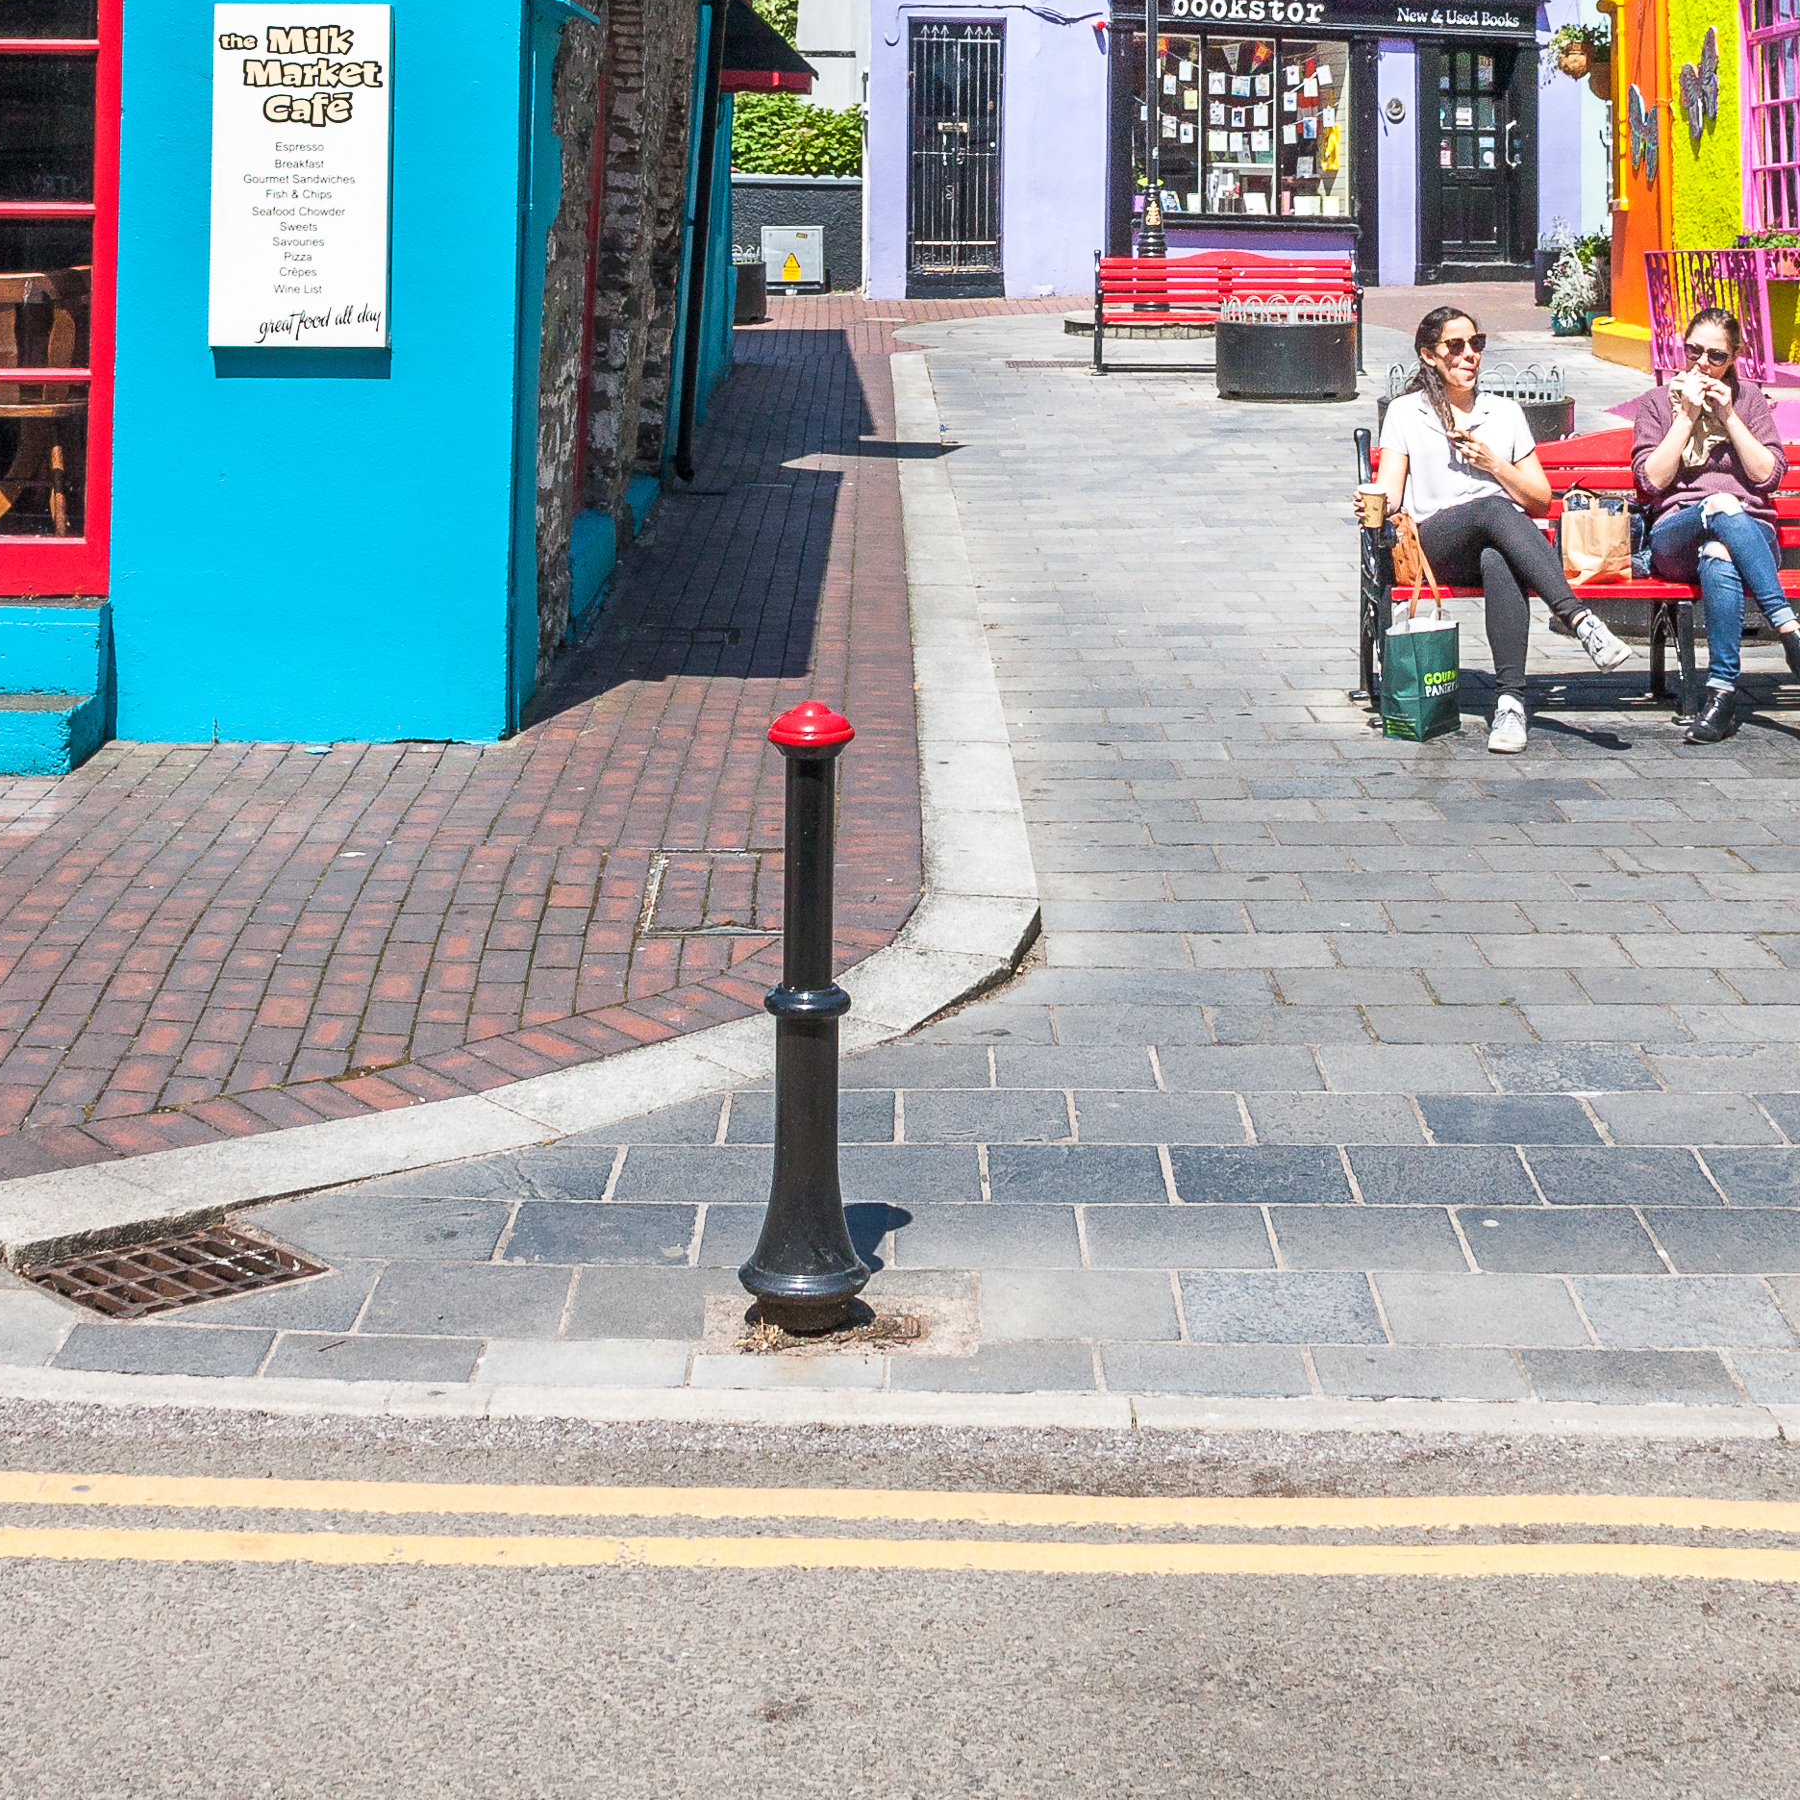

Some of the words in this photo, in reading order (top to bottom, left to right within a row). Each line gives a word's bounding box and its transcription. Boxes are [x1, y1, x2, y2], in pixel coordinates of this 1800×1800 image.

[1397, 7, 1428, 23] New
[1431, 9, 1443, 23] &
[1446, 9, 1479, 26] Used
[1482, 11, 1520, 28] Books
[220, 33, 257, 50] the
[267, 25, 354, 54] Milk
[244, 59, 383, 88] Market
[275, 142, 324, 153] Espresso
[275, 159, 324, 169] Breakfast
[243, 174, 289, 184] Gourmet
[292, 174, 356, 184] Sandwiches
[266, 189, 288, 199] Fish
[291, 189, 299, 199] &
[302, 189, 332, 201] Chips
[252, 206, 296, 216] Seafood
[299, 206, 346, 216] Chowder
[280, 221, 318, 231] Sweets
[272, 236, 325, 246] Savouries
[284, 251, 313, 261] Pizza
[273, 284, 300, 294] Wine
[303, 284, 322, 294] List
[254, 310, 300, 344] great
[295, 307, 332, 341] food
[335, 305, 354, 325] all
[357, 302, 381, 332] day
